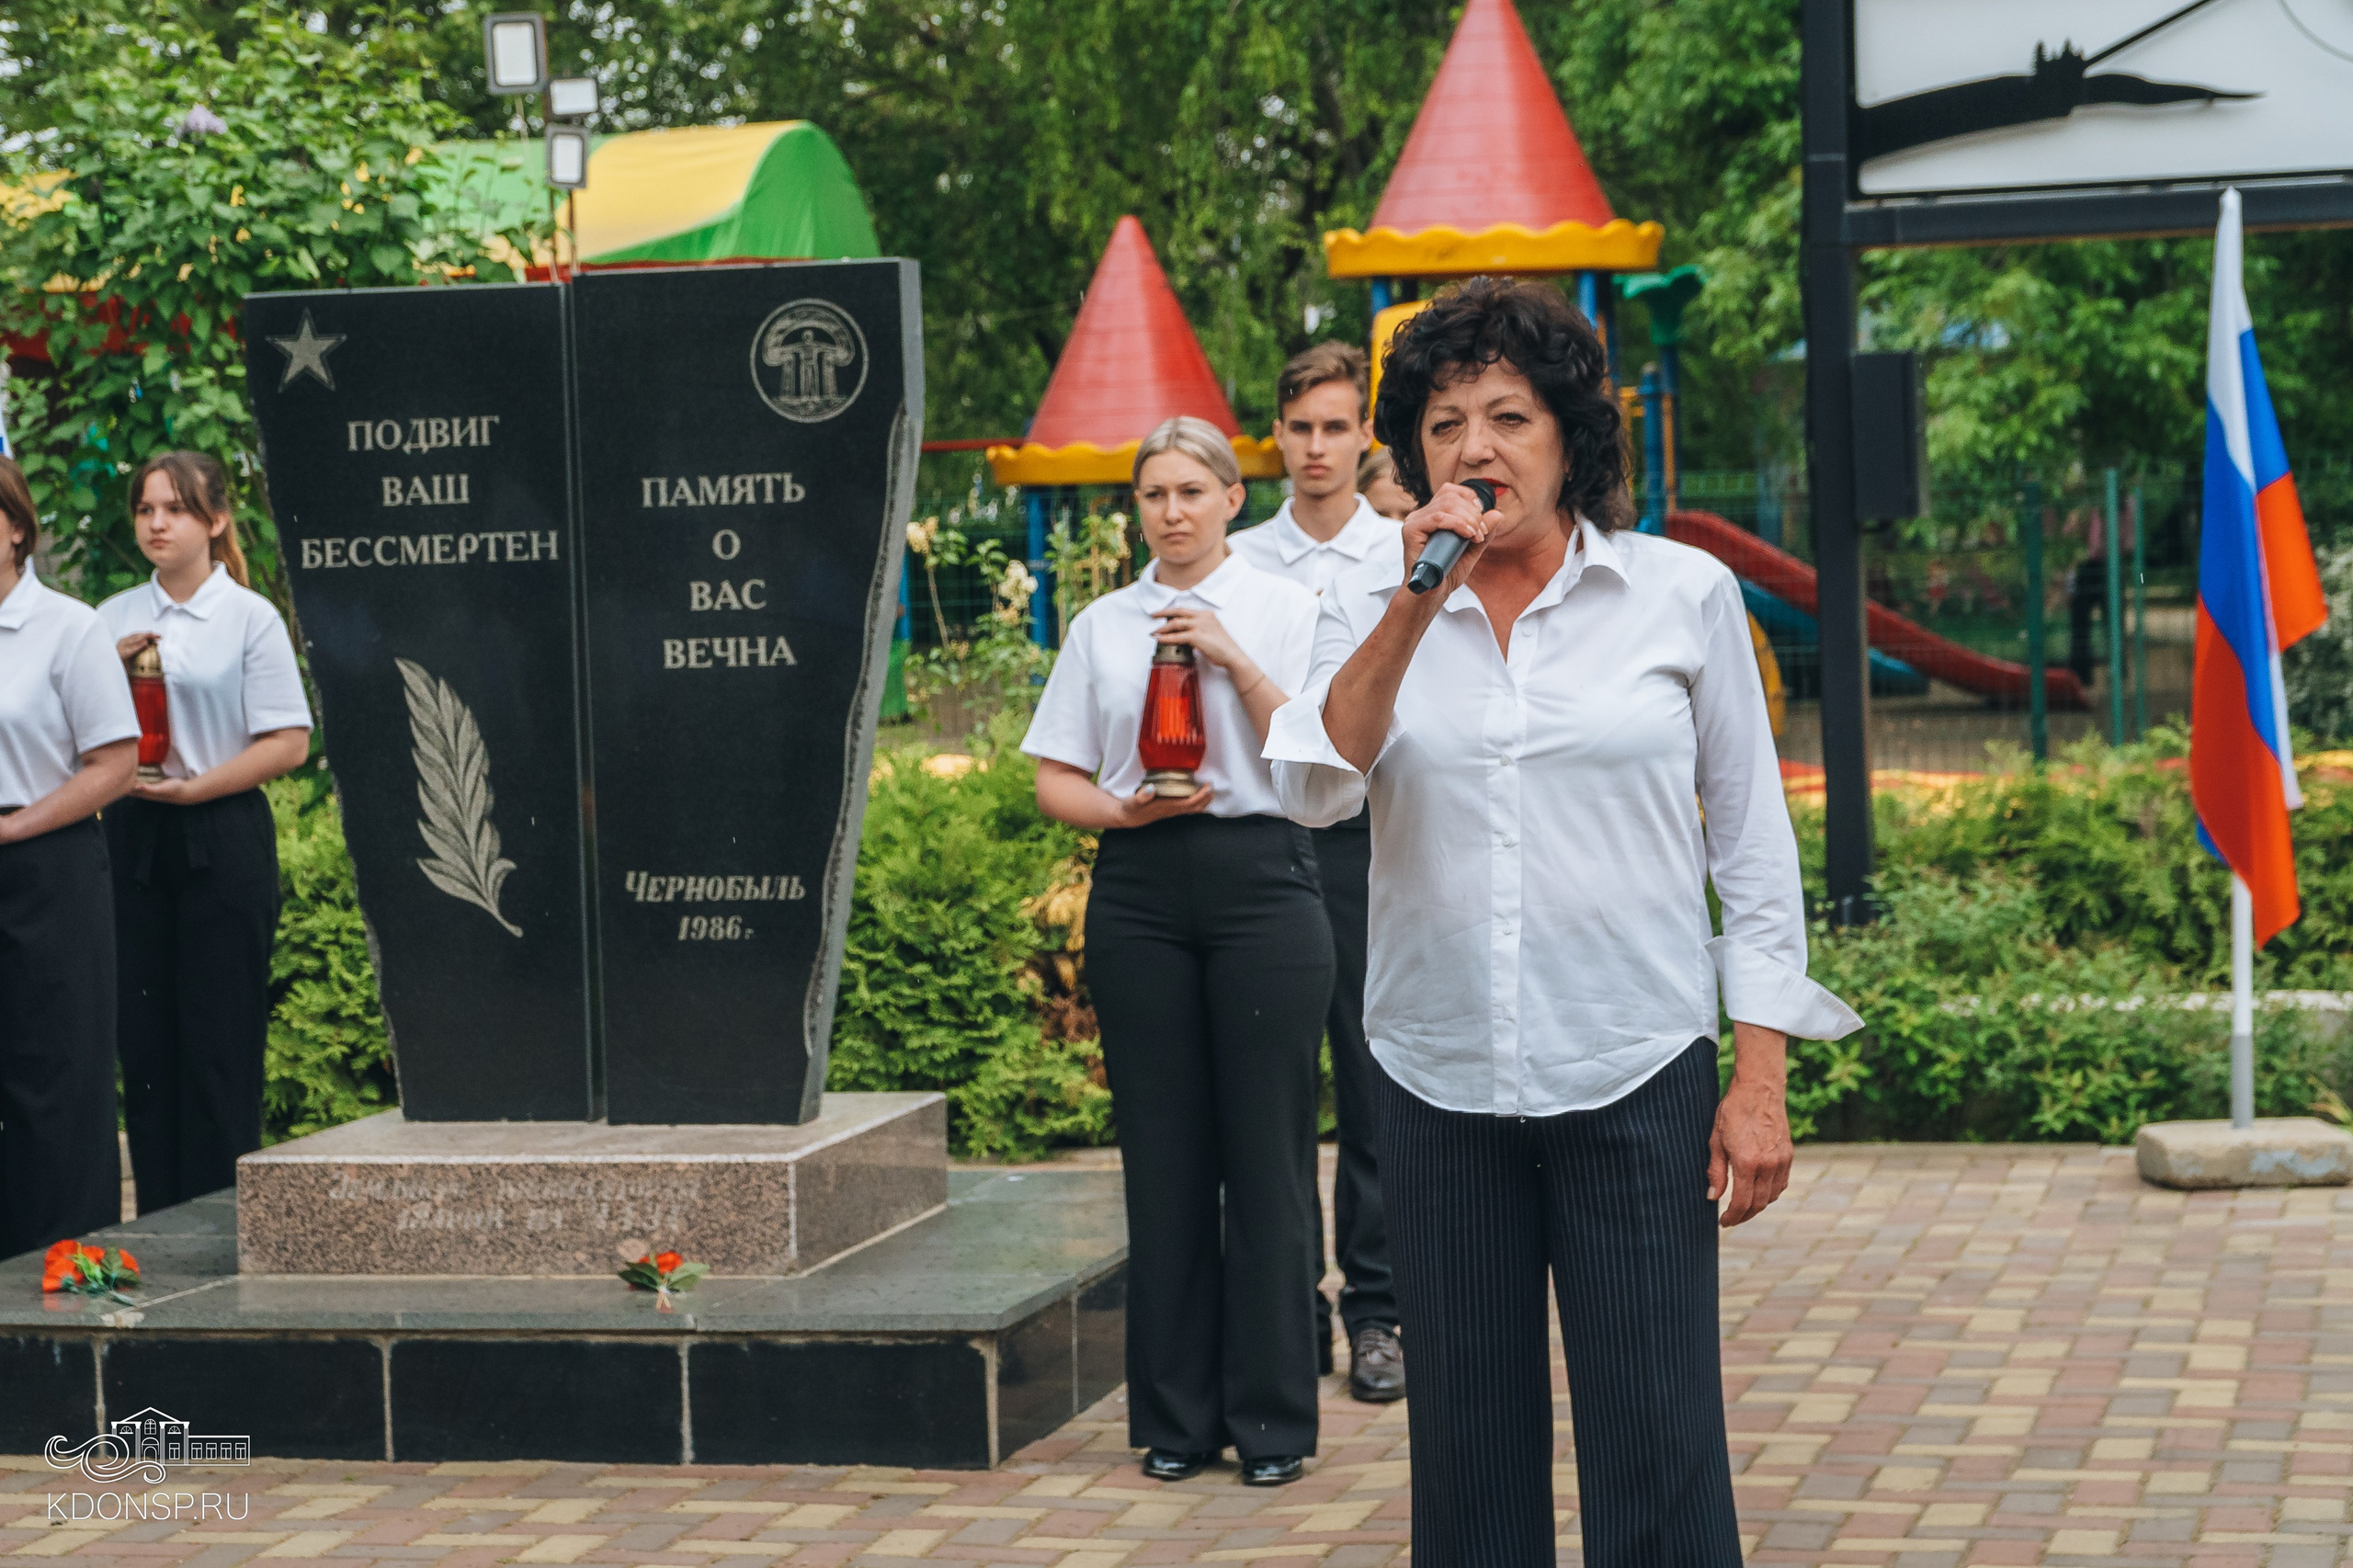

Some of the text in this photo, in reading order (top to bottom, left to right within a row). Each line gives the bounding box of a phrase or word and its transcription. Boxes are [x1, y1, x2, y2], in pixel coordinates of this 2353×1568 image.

[347, 415, 499, 454] ПОДВИГ
[381, 473, 470, 507] ВАШ
[642, 472, 805, 507] ПАМЯТЬ
[301, 529, 559, 569] БЕССМЕРТЕН
[711, 528, 741, 561] О
[689, 578, 767, 611] ВАС
[663, 636, 797, 669] ВЕЧНА
